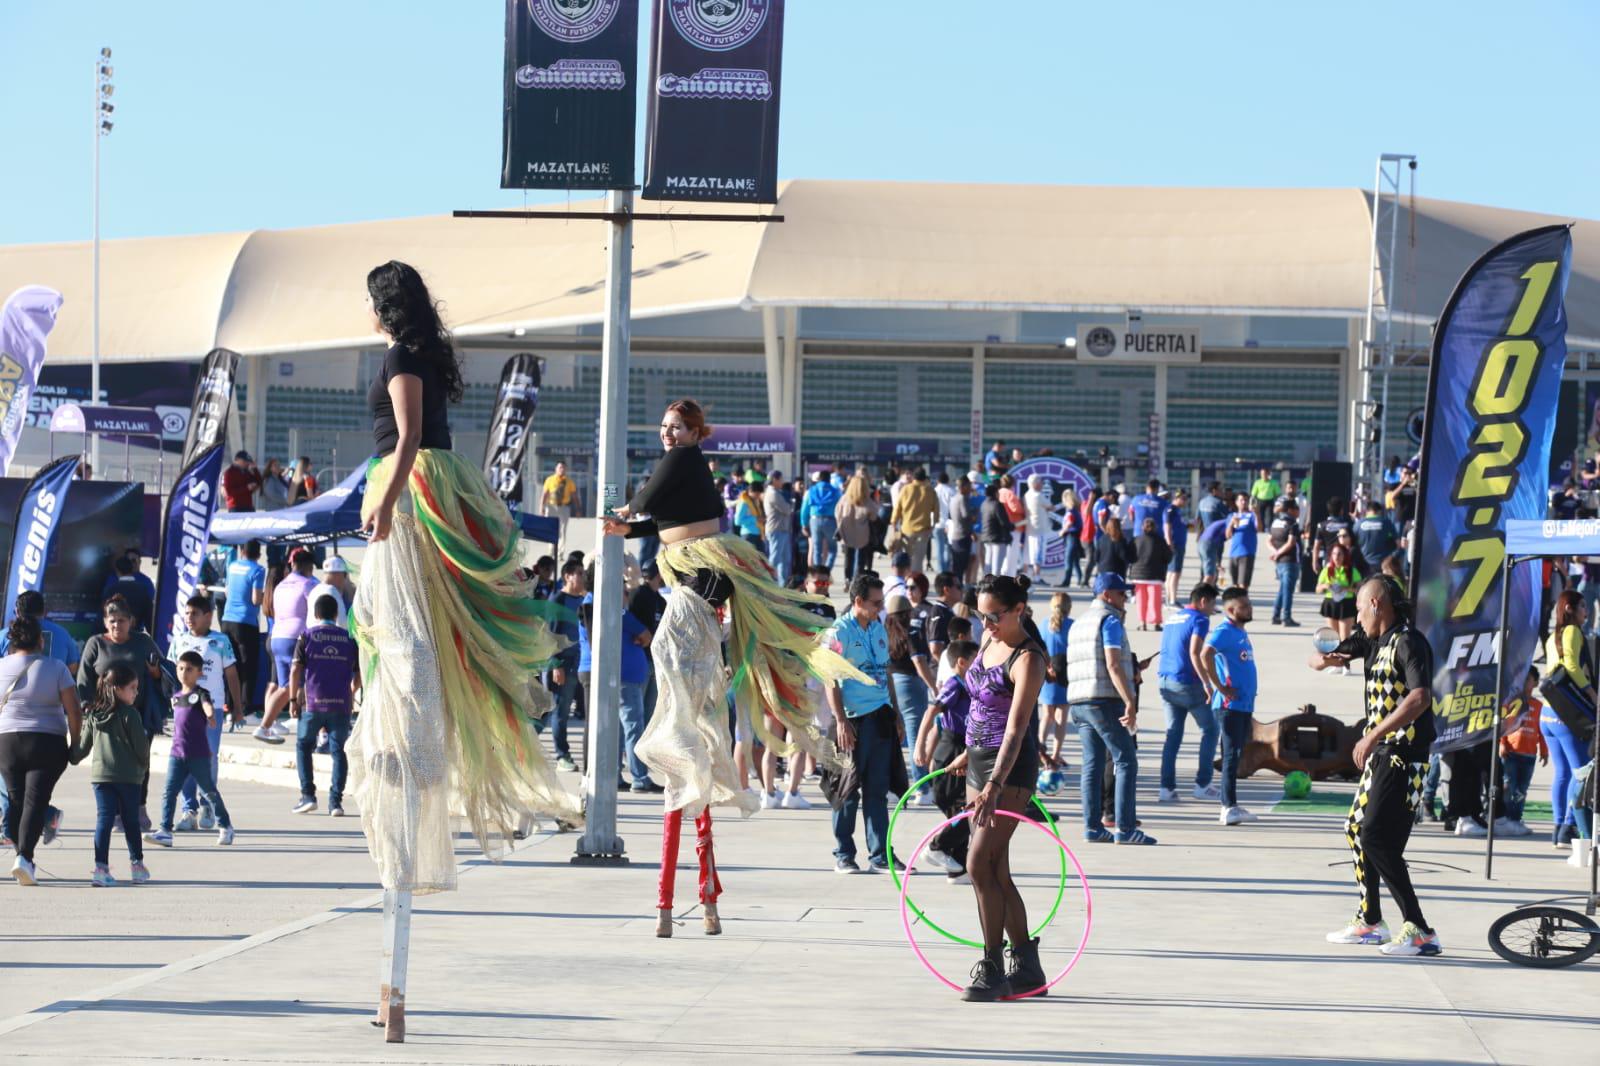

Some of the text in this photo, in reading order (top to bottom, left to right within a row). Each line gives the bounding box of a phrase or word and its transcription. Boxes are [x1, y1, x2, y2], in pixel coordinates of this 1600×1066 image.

[599, 3, 611, 22] CLUB
[745, 12, 759, 31] CLUB
[1124, 333, 1186, 353] PUERTA
[497, 422, 523, 449] 12
[1446, 631, 1504, 670] FM
[1432, 693, 1497, 724] Mejor
